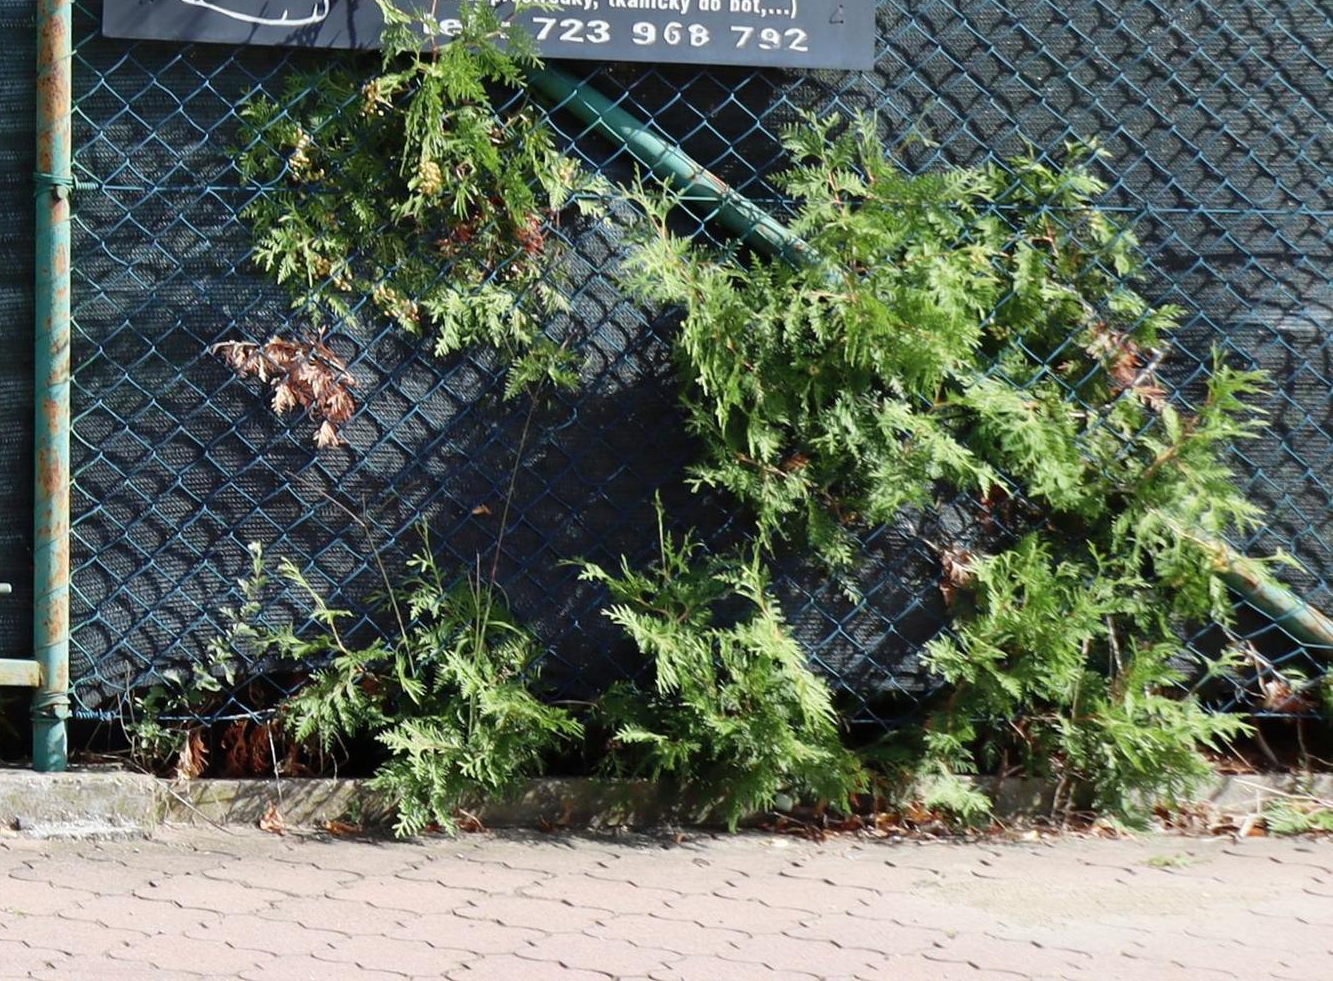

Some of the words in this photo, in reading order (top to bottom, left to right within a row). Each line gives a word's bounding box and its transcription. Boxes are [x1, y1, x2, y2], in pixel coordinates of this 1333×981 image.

[533, 16, 612, 43] 723
[632, 21, 711, 48] 968
[730, 25, 810, 53] 792
